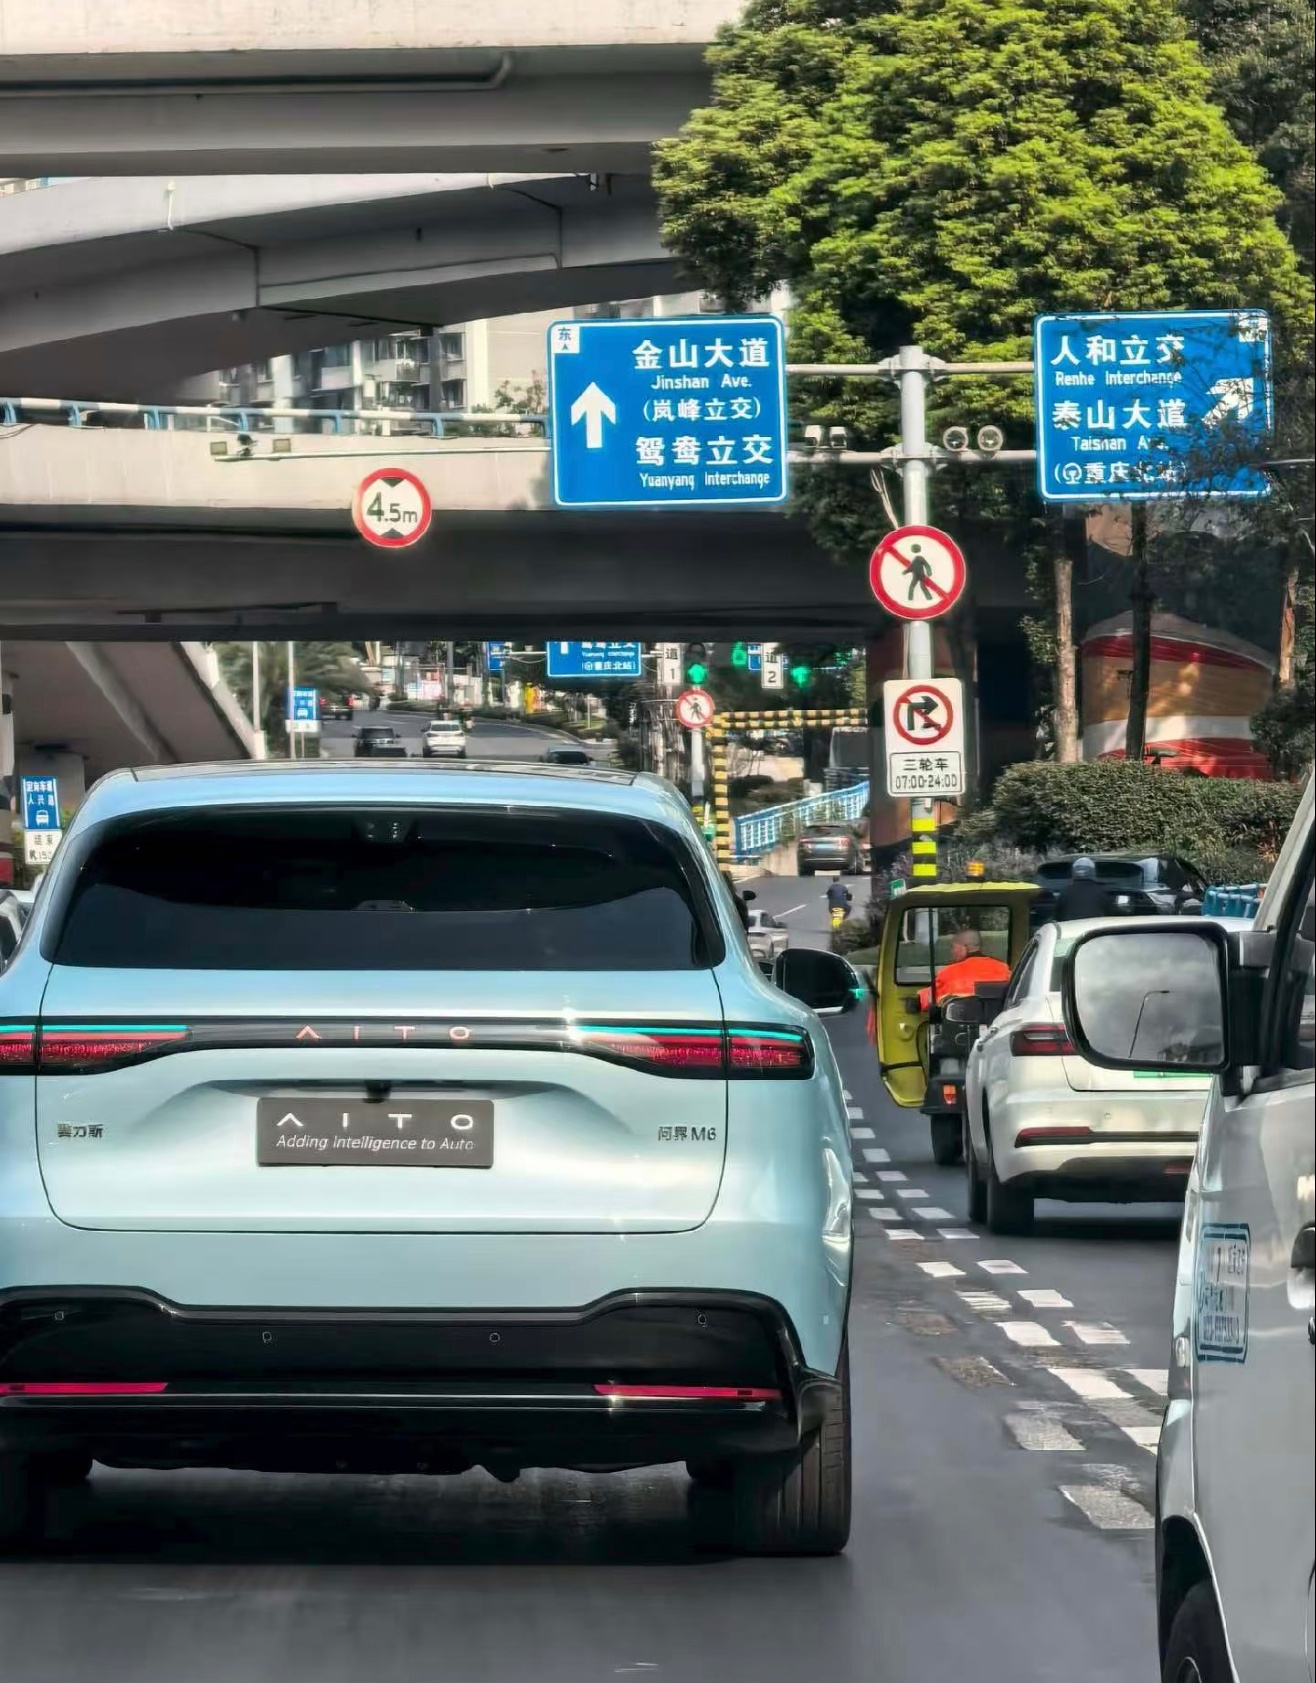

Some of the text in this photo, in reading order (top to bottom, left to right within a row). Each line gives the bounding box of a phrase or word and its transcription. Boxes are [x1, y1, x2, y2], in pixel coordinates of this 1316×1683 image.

[632, 338, 770, 370] 金山大道
[1050, 334, 1185, 366] 人和立交
[650, 375, 753, 391] Jinshan Ave.
[1055, 370, 1096, 386] Renhe
[643, 396, 761, 422] (岚峰立交)
[1051, 398, 1187, 431] 泰山大道
[635, 434, 774, 467] 鸳鸯立交
[639, 471, 771, 491] Yuanyang Interchange
[366, 491, 418, 523] 4.5m
[767, 670, 777, 683] 2
[903, 758, 950, 772] 三轮车
[895, 774, 958, 790] 07:00-24:00
[296, 1025, 471, 1041] AITO
[276, 1112, 474, 1131] AITO
[276, 1134, 475, 1152] Adding Intelligence to Auto
